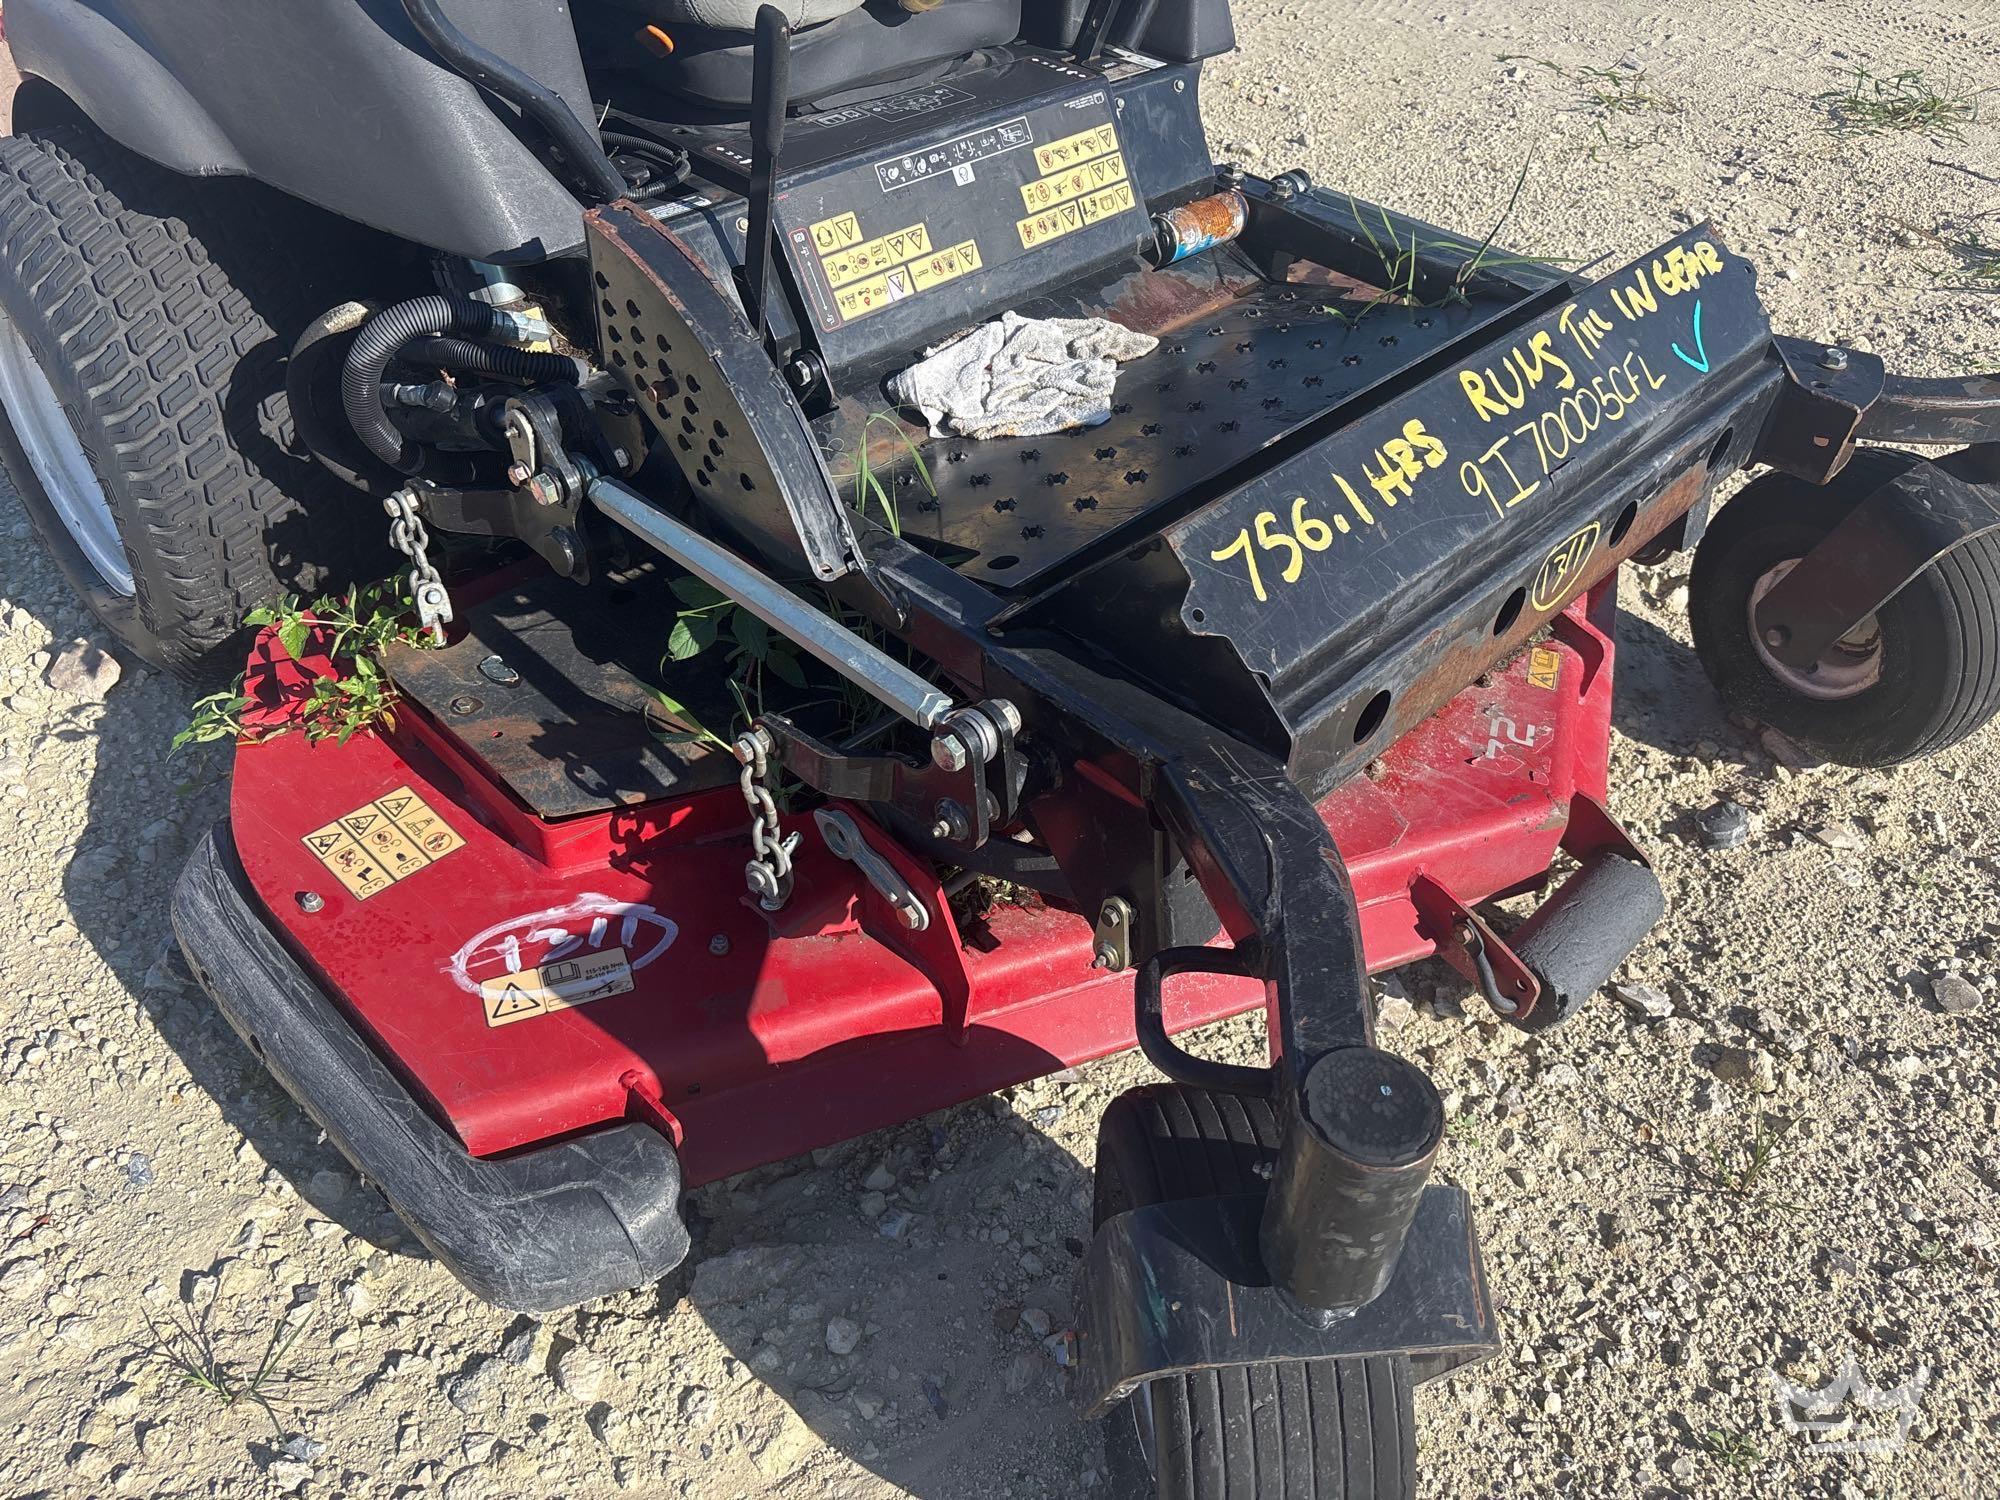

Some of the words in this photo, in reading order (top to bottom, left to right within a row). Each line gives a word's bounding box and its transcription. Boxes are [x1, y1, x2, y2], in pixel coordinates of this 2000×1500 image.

[1210, 472, 1375, 602] 756.1
[1361, 418, 1449, 508] HRS
[1459, 330, 1576, 423] RUNS
[1609, 267, 1658, 322] IN
[1652, 240, 1724, 297] GEAR
